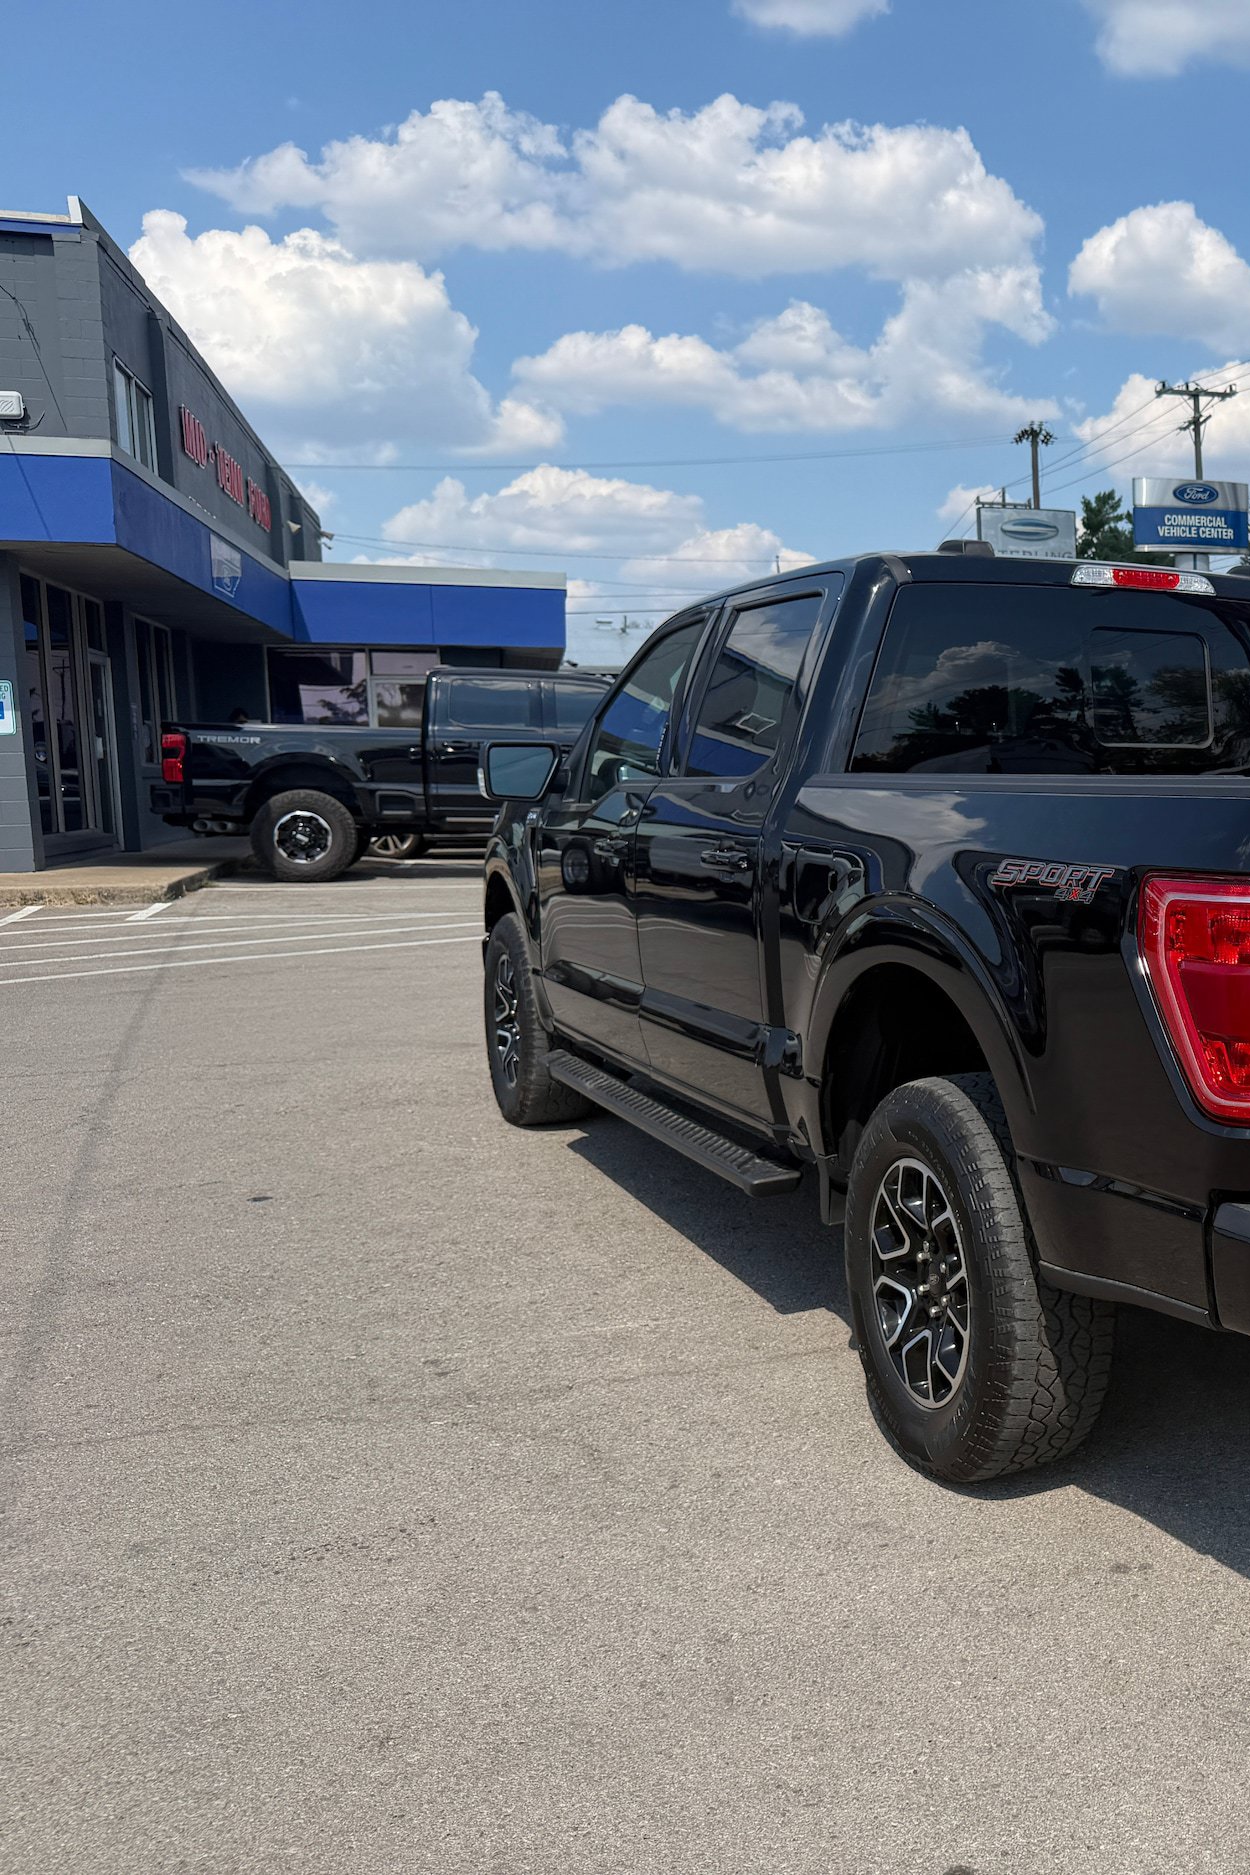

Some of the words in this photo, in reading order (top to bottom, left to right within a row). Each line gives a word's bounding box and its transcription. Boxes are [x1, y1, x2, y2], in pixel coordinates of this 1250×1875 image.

[1183, 487, 1211, 500] Ford
[1164, 514, 1227, 528] COMMERCIAL
[1157, 526, 1198, 538] VEHICLE
[1199, 527, 1234, 540] CENTER
[197, 735, 261, 744] TREMOR
[991, 858, 1115, 892] SPORT
